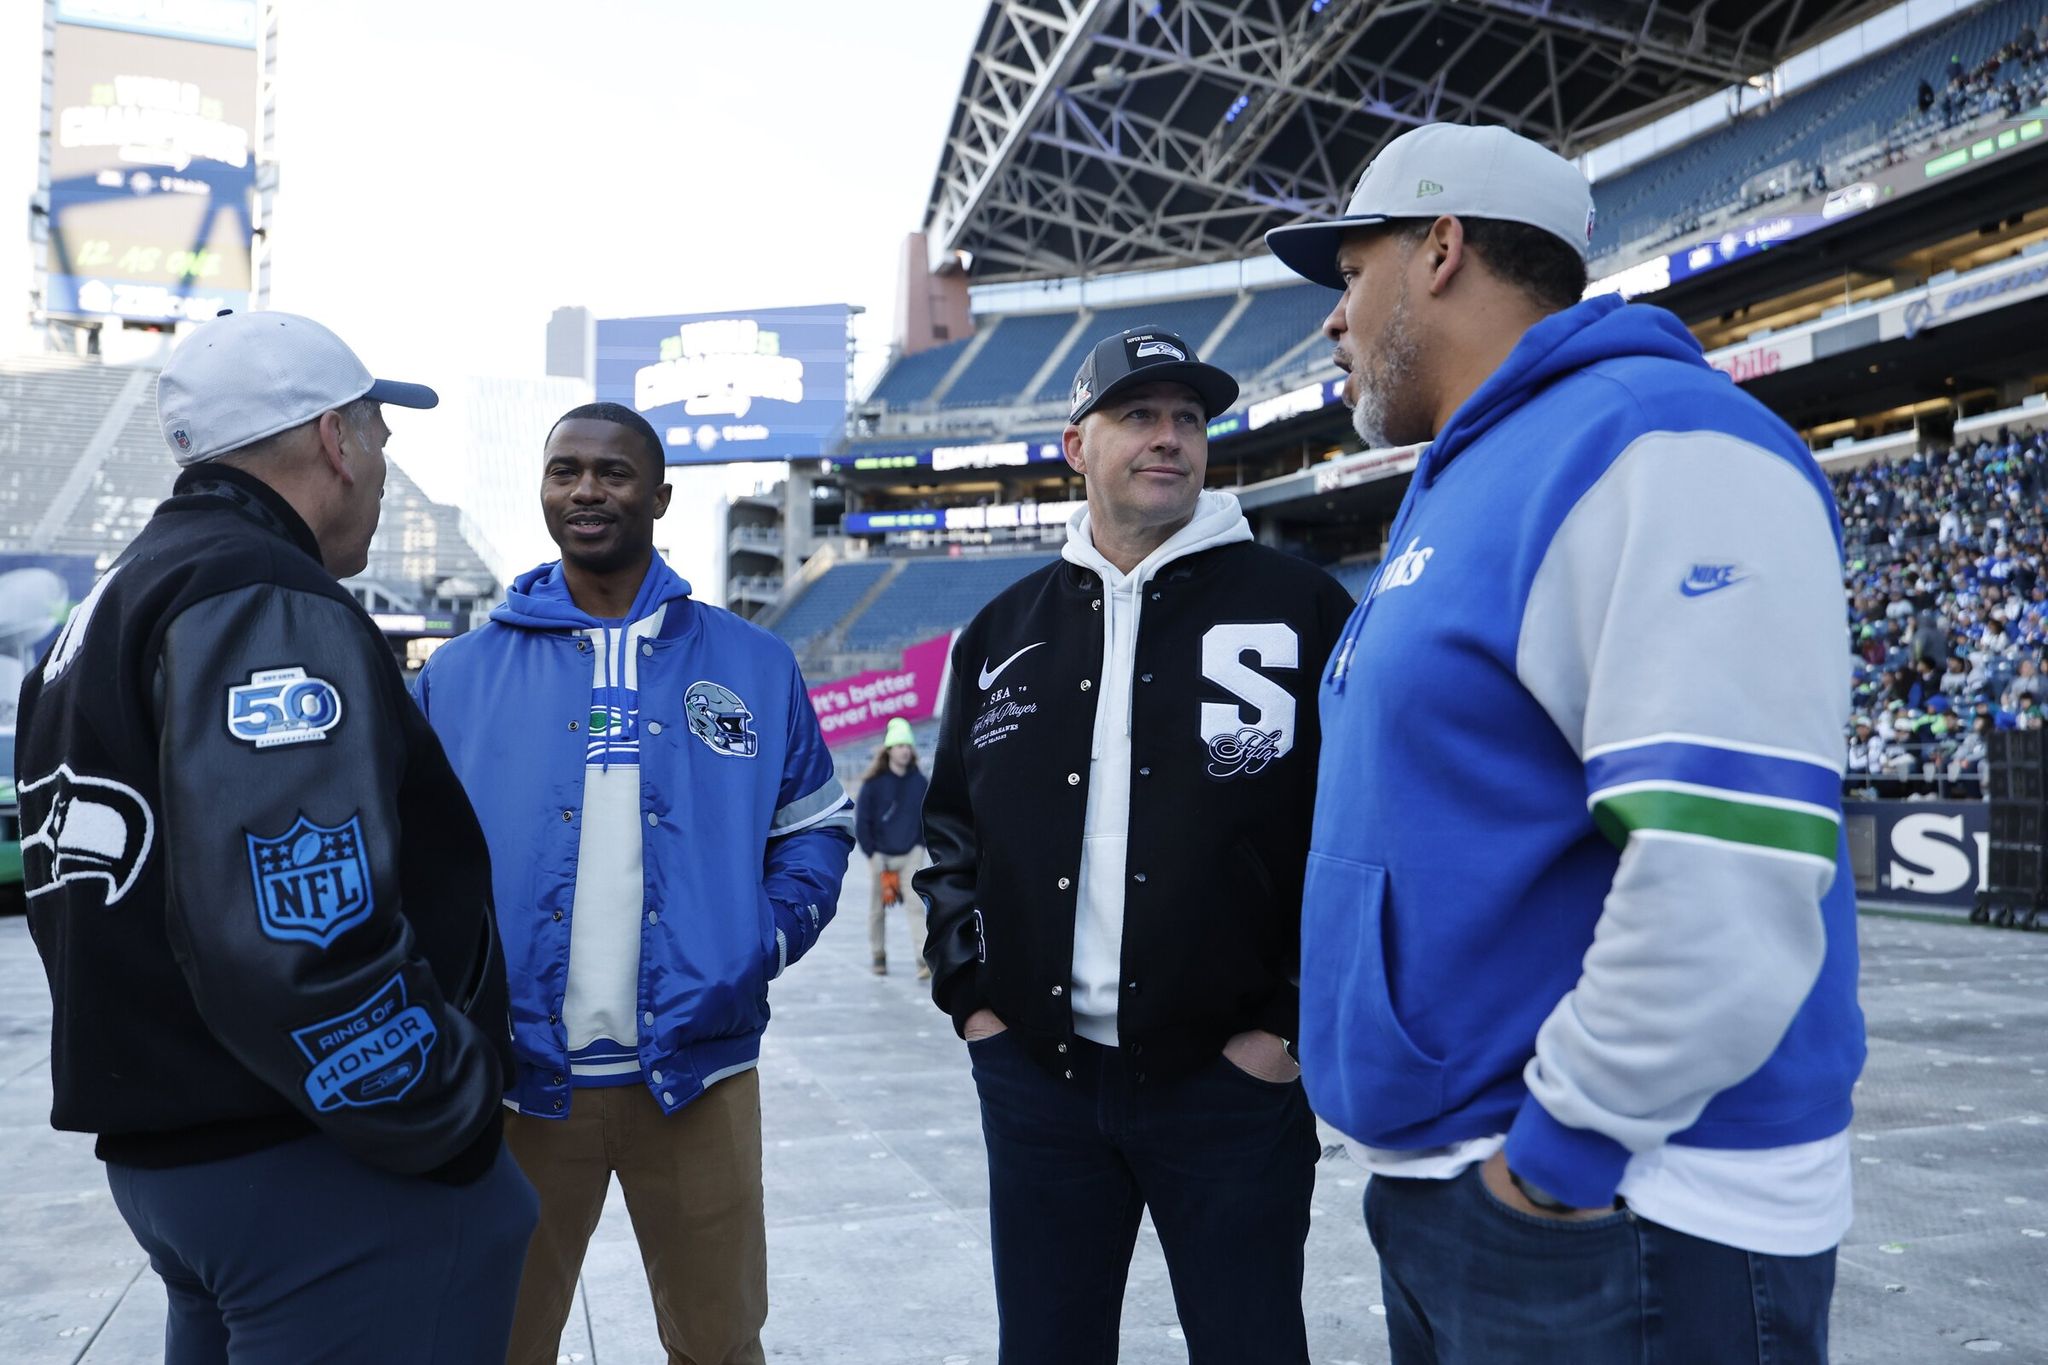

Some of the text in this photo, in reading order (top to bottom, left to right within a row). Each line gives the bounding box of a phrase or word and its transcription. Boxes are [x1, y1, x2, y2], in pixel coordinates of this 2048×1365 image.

[1690, 565, 1735, 584] NIKE
[232, 682, 338, 736] 50
[848, 672, 916, 704] better
[990, 687, 1010, 704] SEA
[1200, 623, 1298, 758] S
[820, 691, 919, 732] over here
[997, 702, 1038, 722] Player
[270, 867, 360, 919] NFL
[319, 999, 395, 1050] RING OF
[316, 1016, 421, 1090] HONOR
